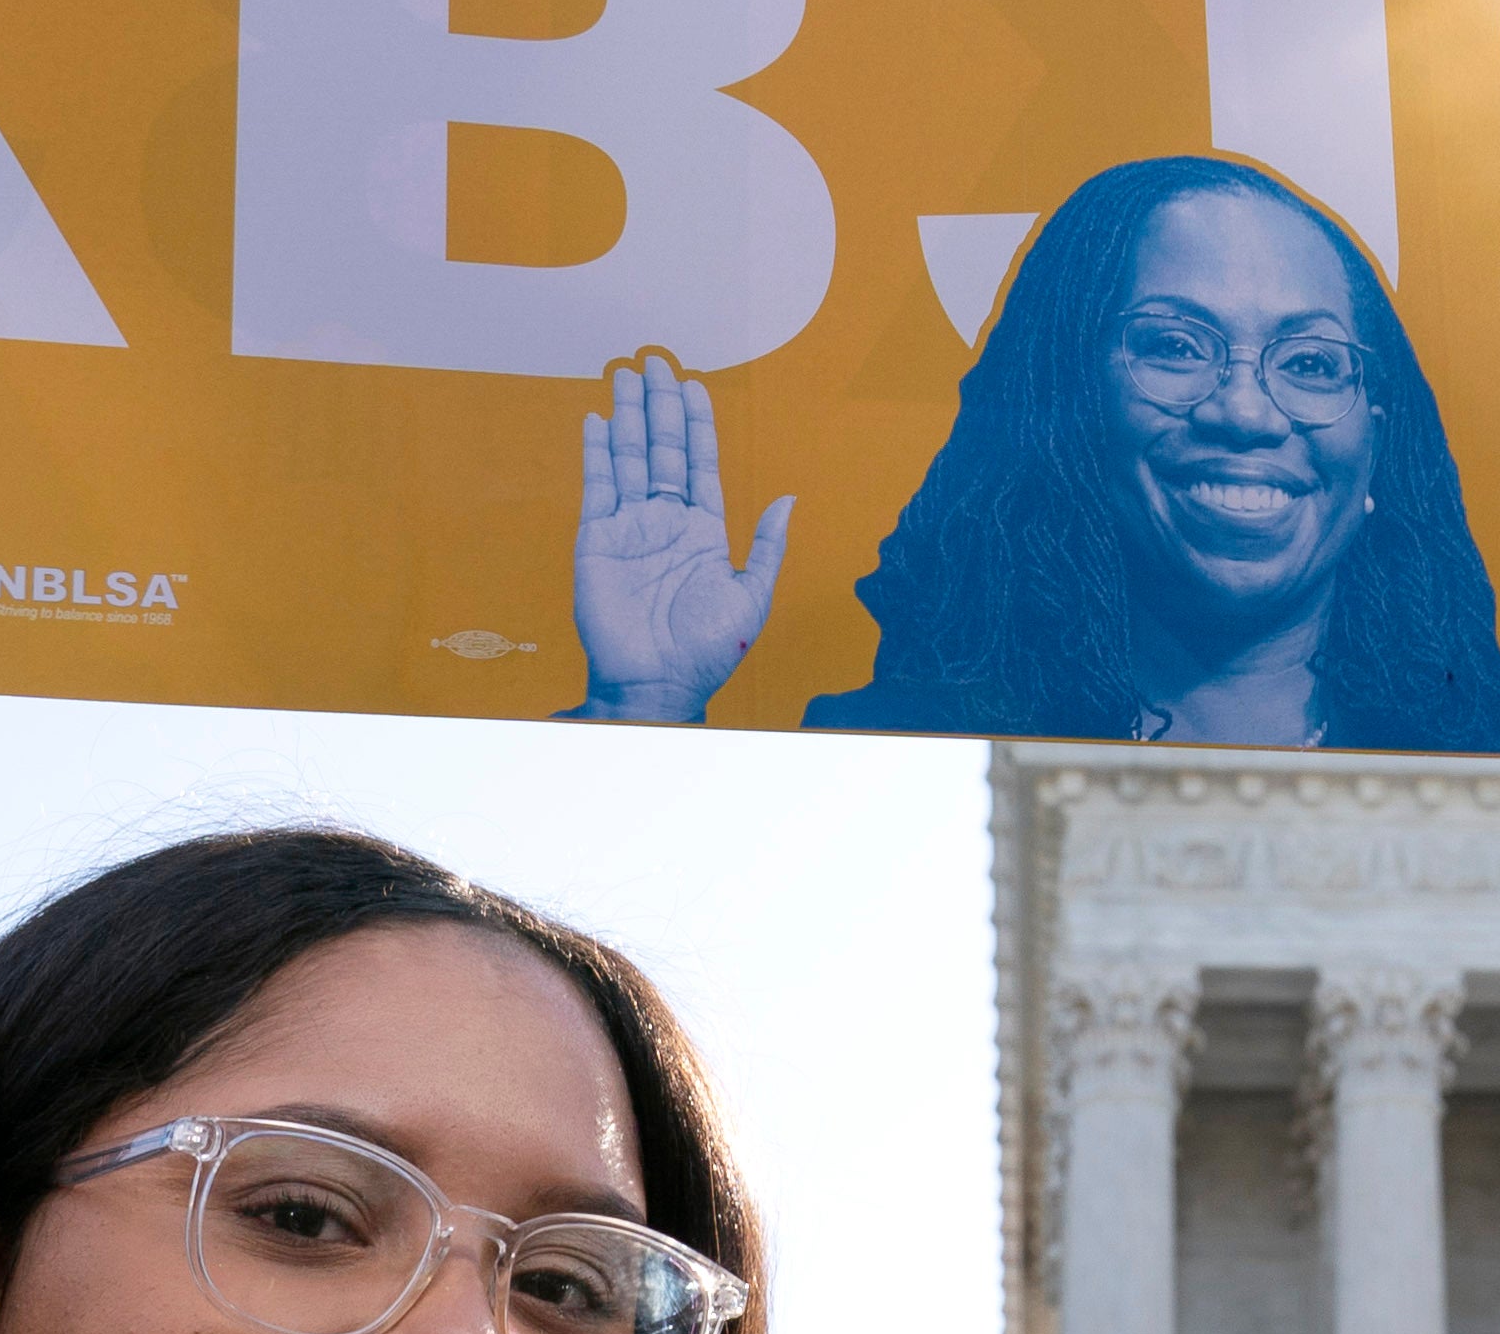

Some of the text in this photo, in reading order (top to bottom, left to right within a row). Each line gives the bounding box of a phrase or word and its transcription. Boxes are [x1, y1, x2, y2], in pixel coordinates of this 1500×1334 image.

[41, 607, 53, 620] to
[56, 608, 104, 623] balance
[106, 611, 138, 625] since
